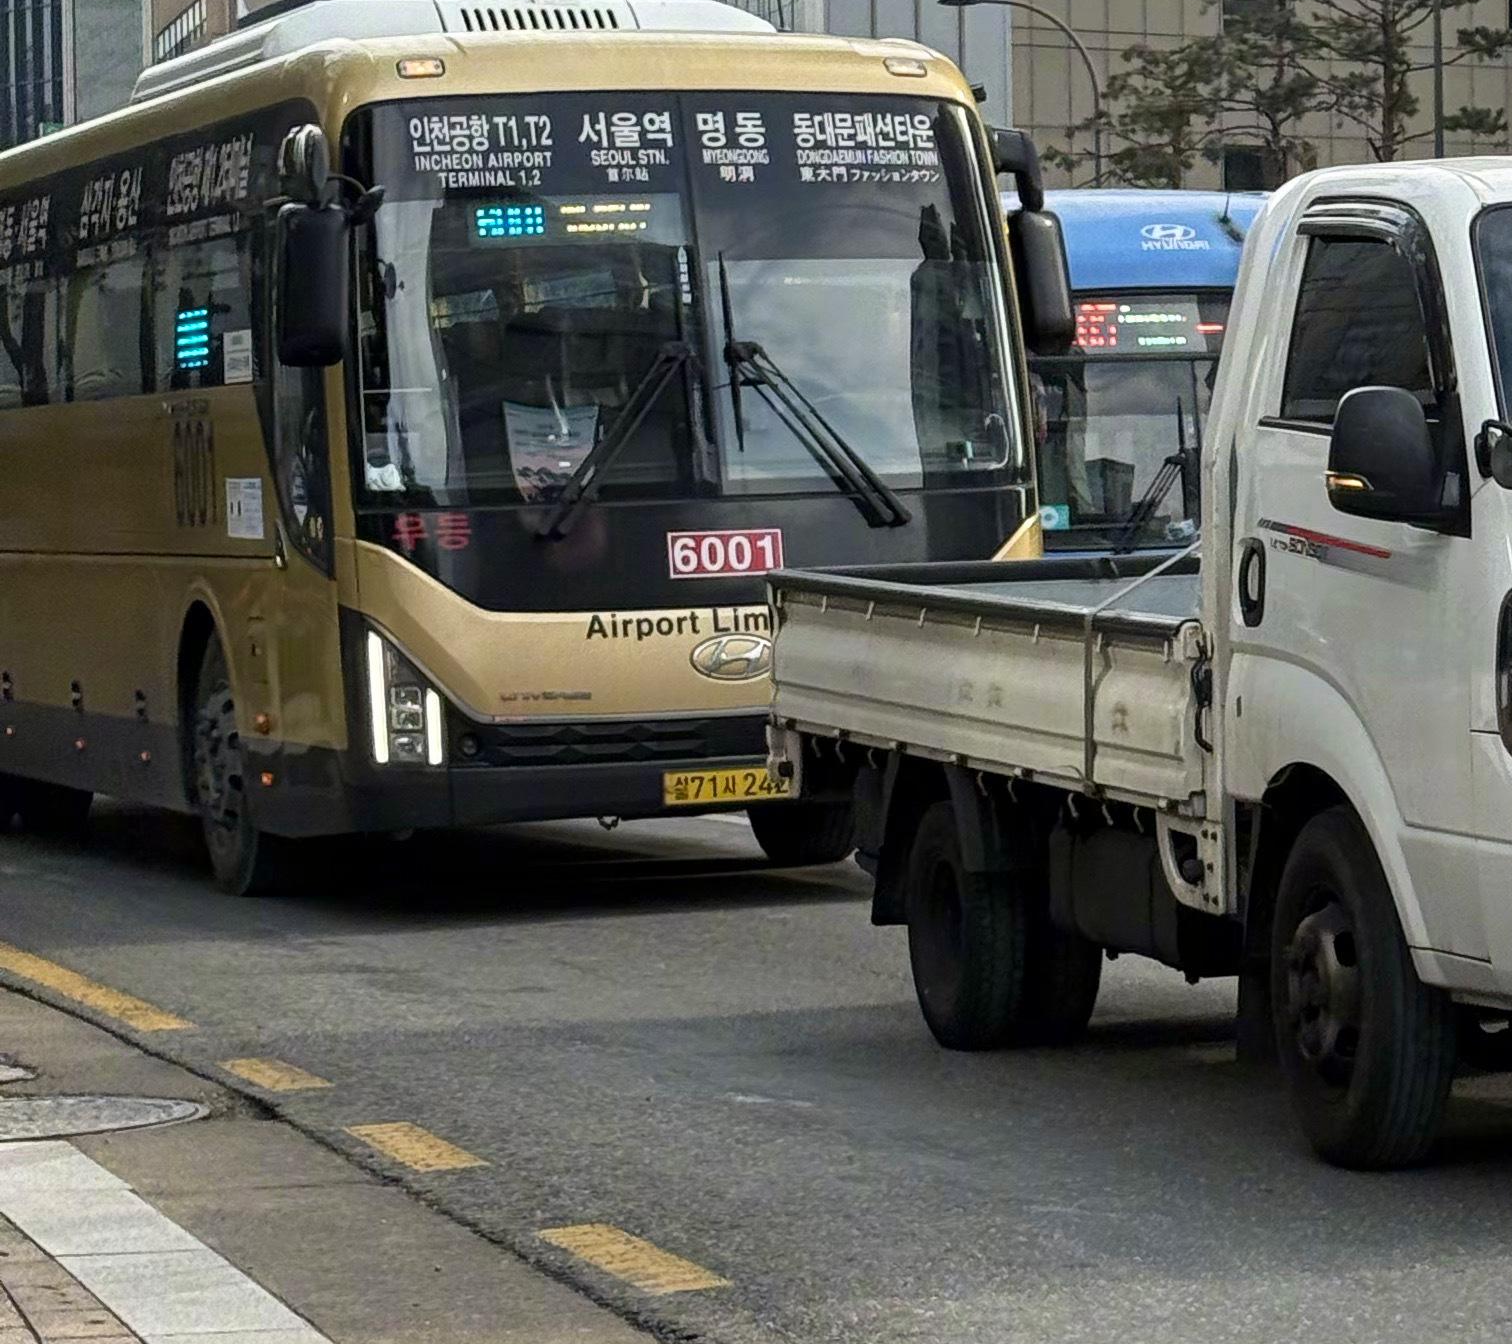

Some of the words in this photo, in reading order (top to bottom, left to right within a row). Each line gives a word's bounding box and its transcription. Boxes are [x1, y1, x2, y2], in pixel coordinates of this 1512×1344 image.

[409, 115, 489, 152] 인천공항
[492, 115, 553, 149] T1,T2
[578, 111, 675, 148] 서울역
[695, 111, 767, 148] 명동
[793, 111, 935, 149] 동대문패션타운
[414, 154, 483, 172] INCHEON
[488, 151, 553, 169] AIRPORT
[591, 150, 637, 166] SEOUL
[702, 149, 770, 165] MYEONGDONG
[796, 149, 866, 165] DONGDAEMUN
[867, 150, 909, 165] FASHION
[911, 150, 938, 166] TOWN
[437, 170, 516, 188] TERMINAL
[1141, 239, 1209, 251] HYUNDAI
[673, 535, 775, 573] 6001
[586, 611, 700, 642] Airport
